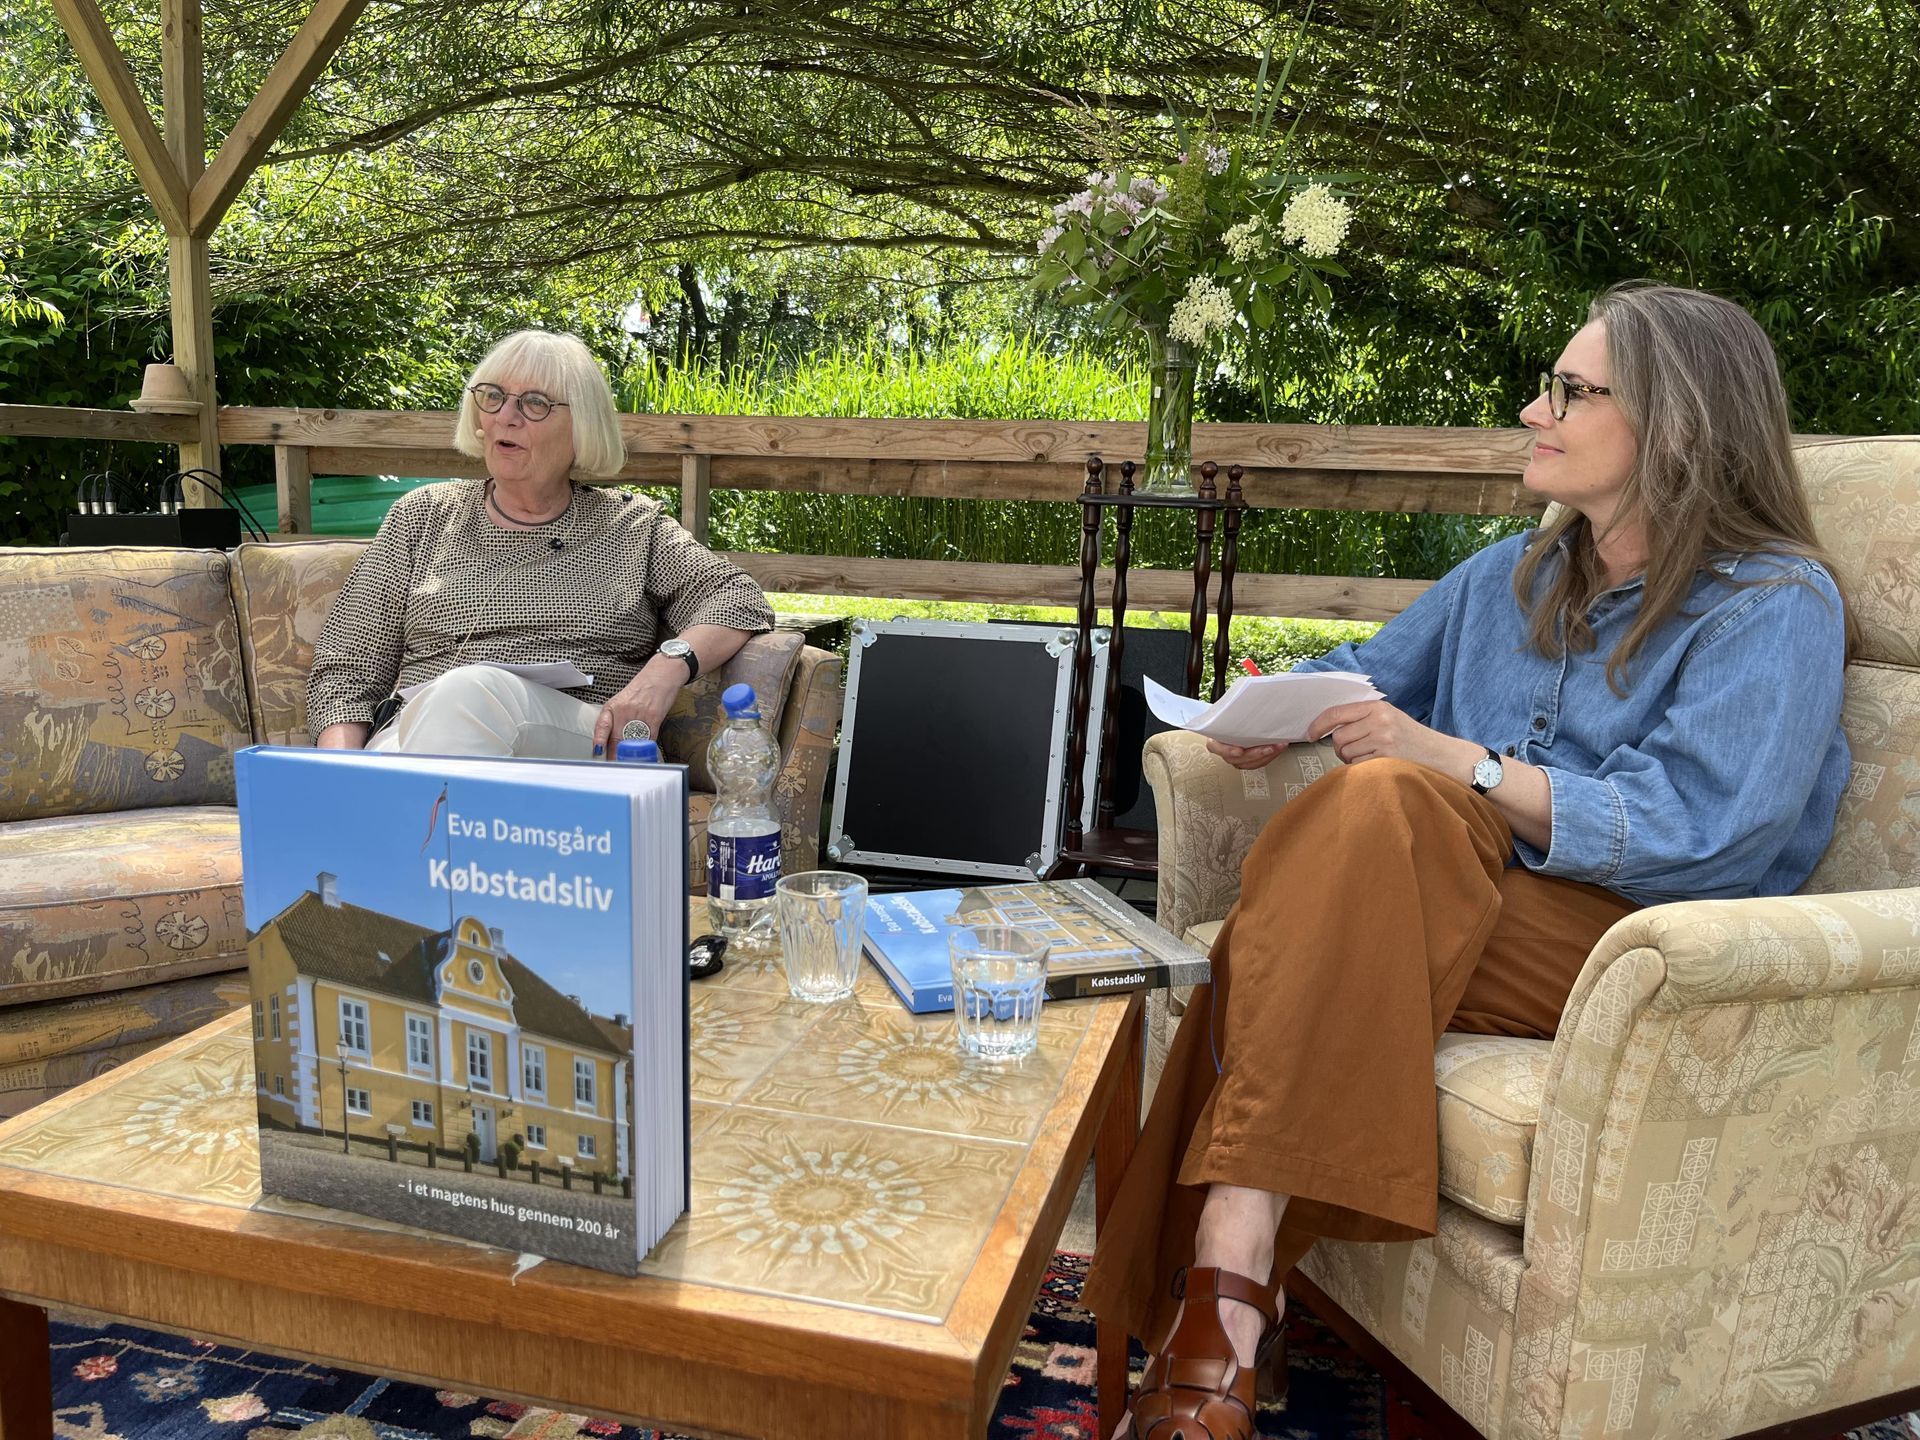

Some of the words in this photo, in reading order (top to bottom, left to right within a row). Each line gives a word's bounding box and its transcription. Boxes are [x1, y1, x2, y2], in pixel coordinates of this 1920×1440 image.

[448, 813, 487, 840] Eva
[493, 818, 611, 855] Damsgård
[429, 858, 613, 911] Købstadsliv
[937, 993, 953, 1003] Eva
[1091, 973, 1146, 988] Købstadsliv
[408, 1179, 412, 1193] i
[415, 1182, 428, 1197] et
[431, 1188, 488, 1210] magtens
[491, 1197, 515, 1216] hus
[518, 1206, 573, 1230] gennem
[576, 1217, 601, 1235] 200
[605, 1222, 620, 1240] år
